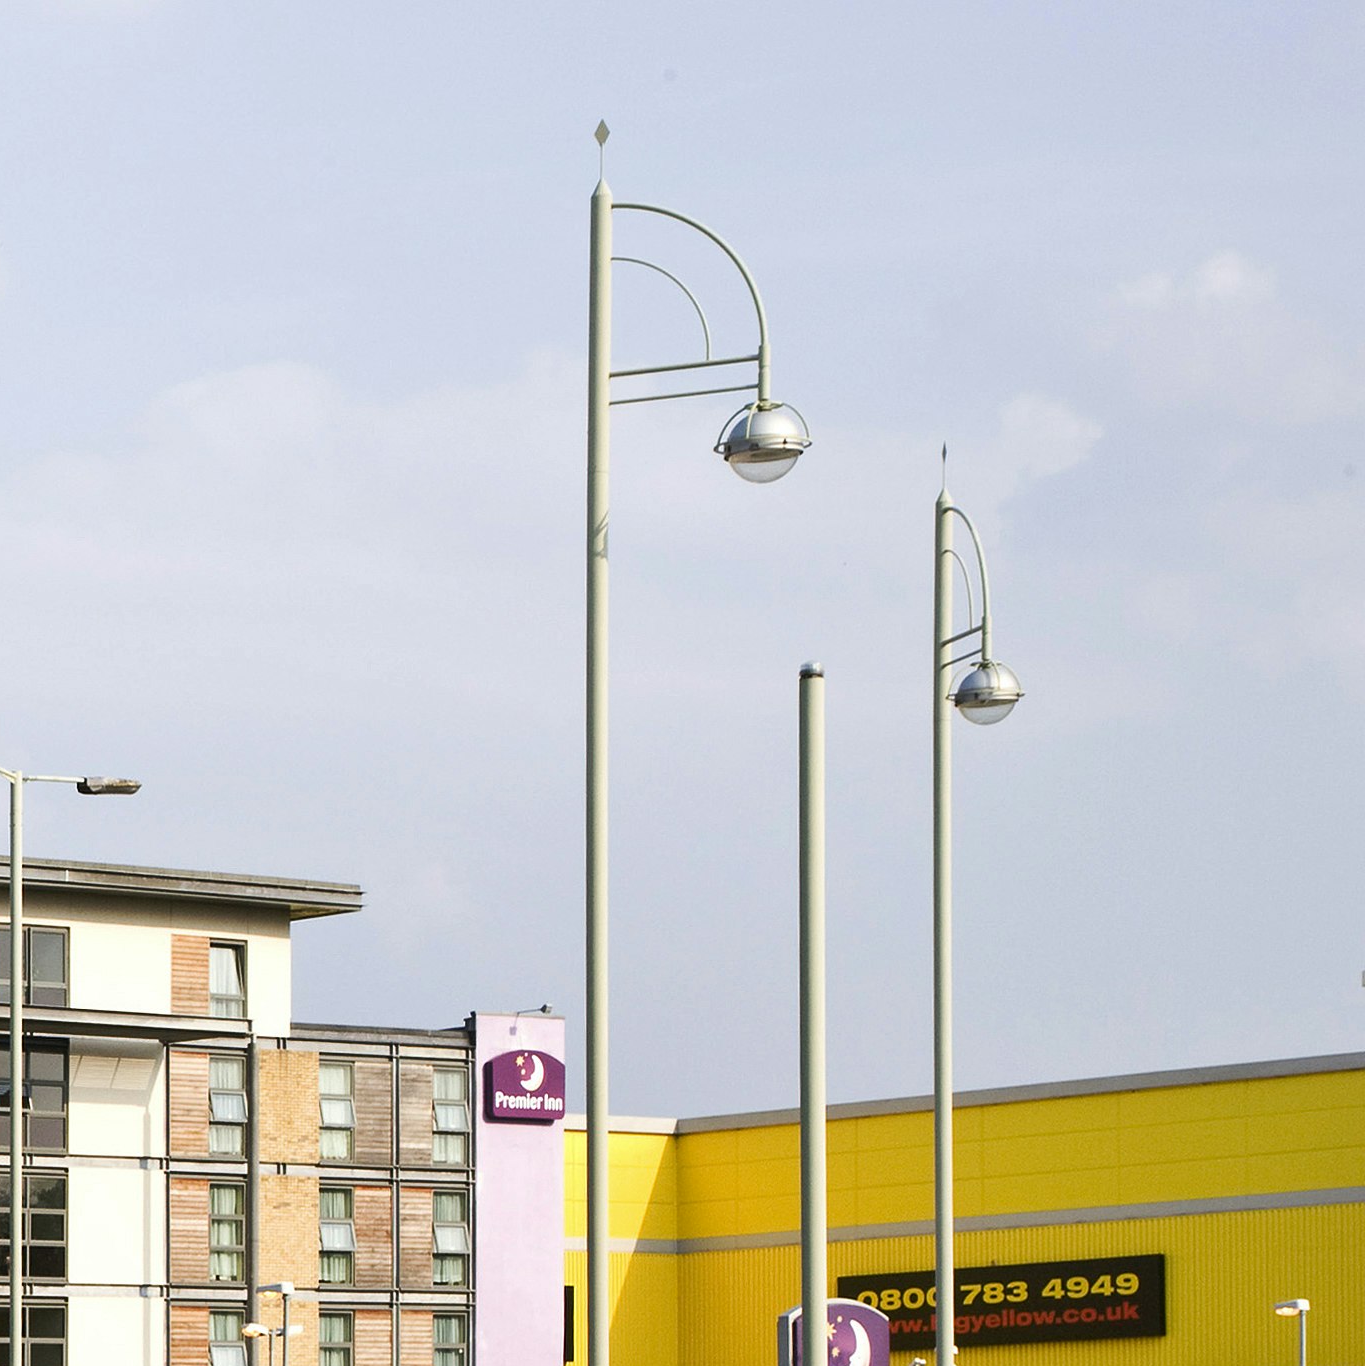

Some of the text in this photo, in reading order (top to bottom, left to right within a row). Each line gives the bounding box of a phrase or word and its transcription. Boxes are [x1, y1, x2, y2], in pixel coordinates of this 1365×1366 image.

[495, 1091, 563, 1111] Premier Inn
[960, 1281, 1028, 1305] 783
[1042, 1273, 1139, 1299] 4949
